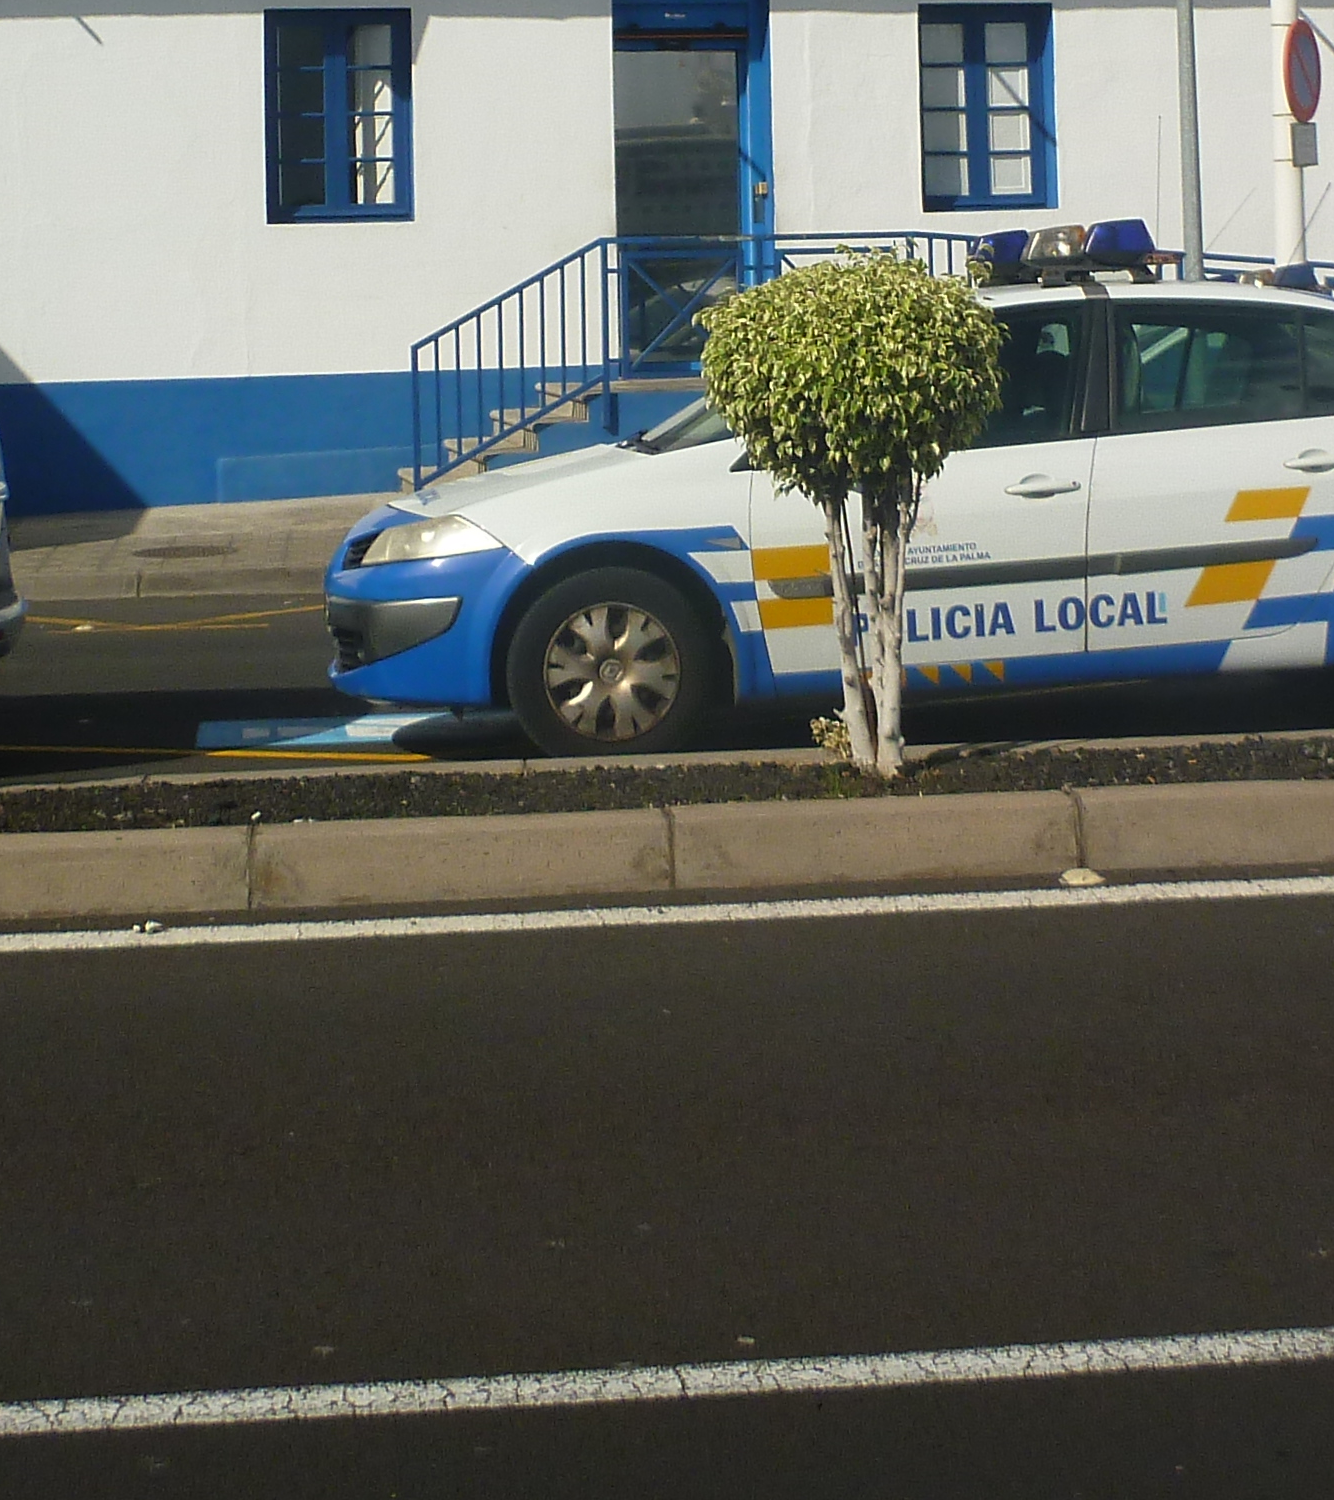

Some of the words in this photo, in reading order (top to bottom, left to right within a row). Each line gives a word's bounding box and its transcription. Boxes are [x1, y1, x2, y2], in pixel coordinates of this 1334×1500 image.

[907, 542, 977, 556] AYUNTAMIENTO
[904, 555, 929, 566] CRUZ
[931, 554, 945, 564] DE
[946, 552, 959, 563] LA
[960, 550, 992, 562] PALMA
[850, 602, 1015, 647] PLICIA
[1034, 591, 1168, 633] LOCAL
